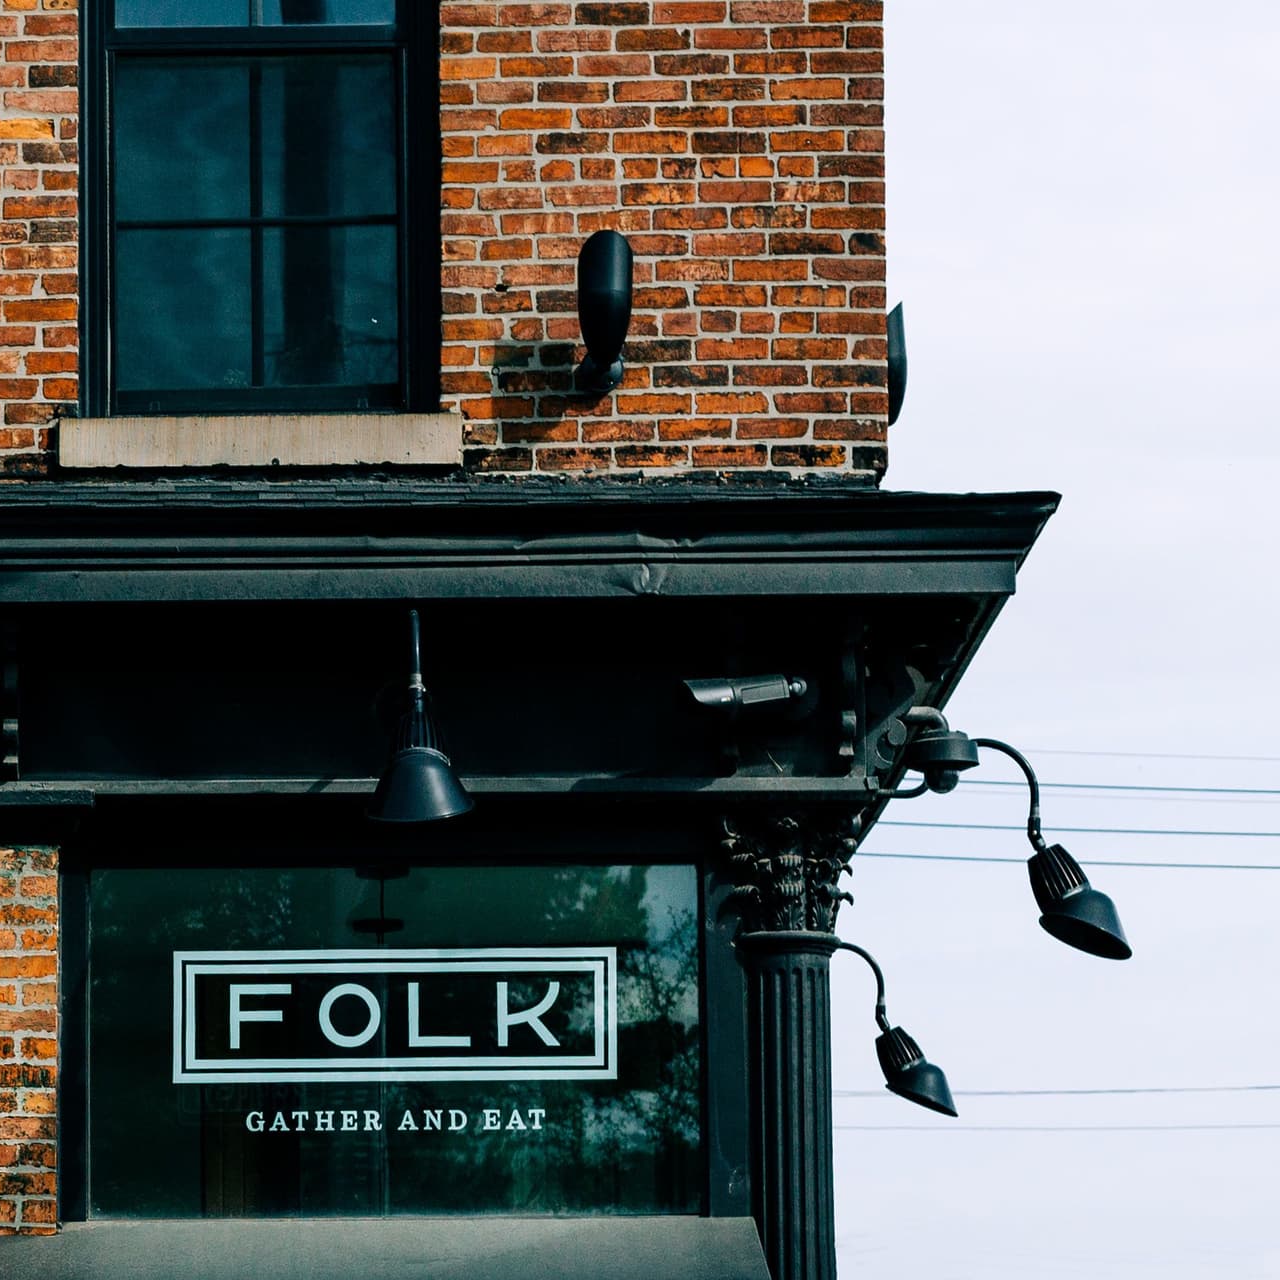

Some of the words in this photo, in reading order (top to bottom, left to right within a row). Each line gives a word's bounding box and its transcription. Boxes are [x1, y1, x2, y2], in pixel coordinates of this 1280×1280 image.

[229, 981, 561, 1050] FOLK
[246, 1109, 383, 1132] GATHER
[397, 1109, 468, 1132] AND
[482, 1108, 546, 1131] EAT
